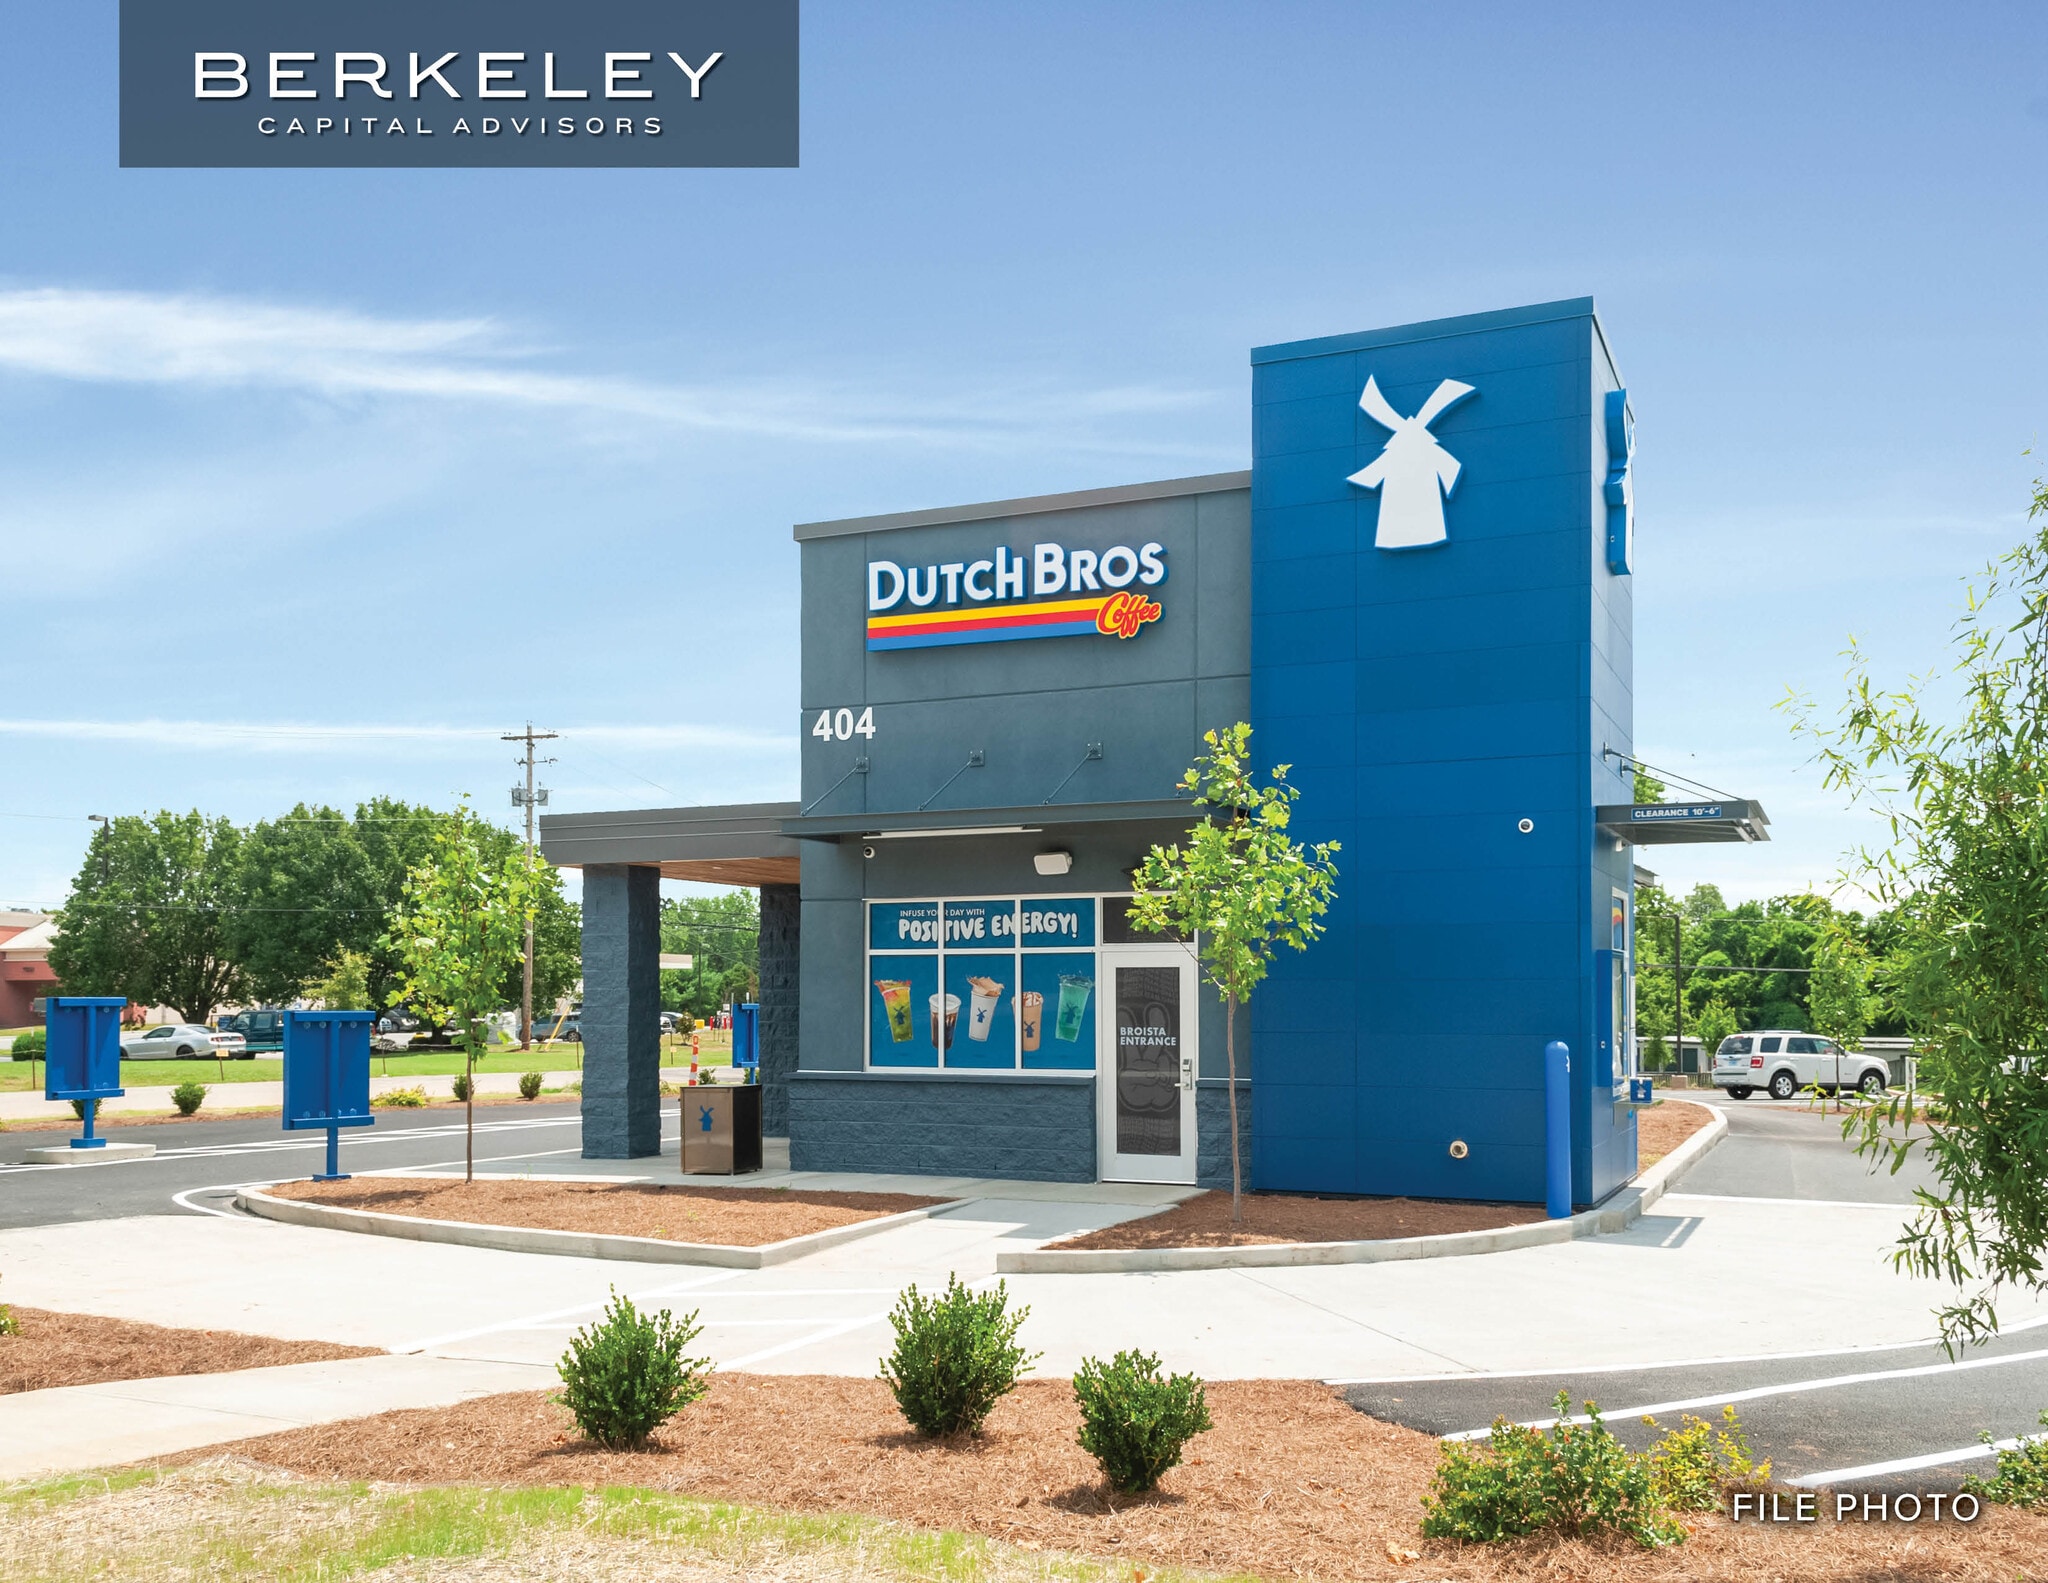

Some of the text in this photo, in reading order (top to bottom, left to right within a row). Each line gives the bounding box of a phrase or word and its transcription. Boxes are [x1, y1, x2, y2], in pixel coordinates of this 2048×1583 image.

[868, 542, 1165, 612] DUTCH BROS
[1096, 591, 1162, 639] Coffee
[812, 707, 876, 741] 404
[1635, 808, 1688, 817] CLEARANCE
[926, 909, 949, 917] YOR
[966, 908, 985, 916] WITH
[1120, 1027, 1166, 1036] BROISTA
[1120, 1036, 1176, 1045] ENTRANCE
